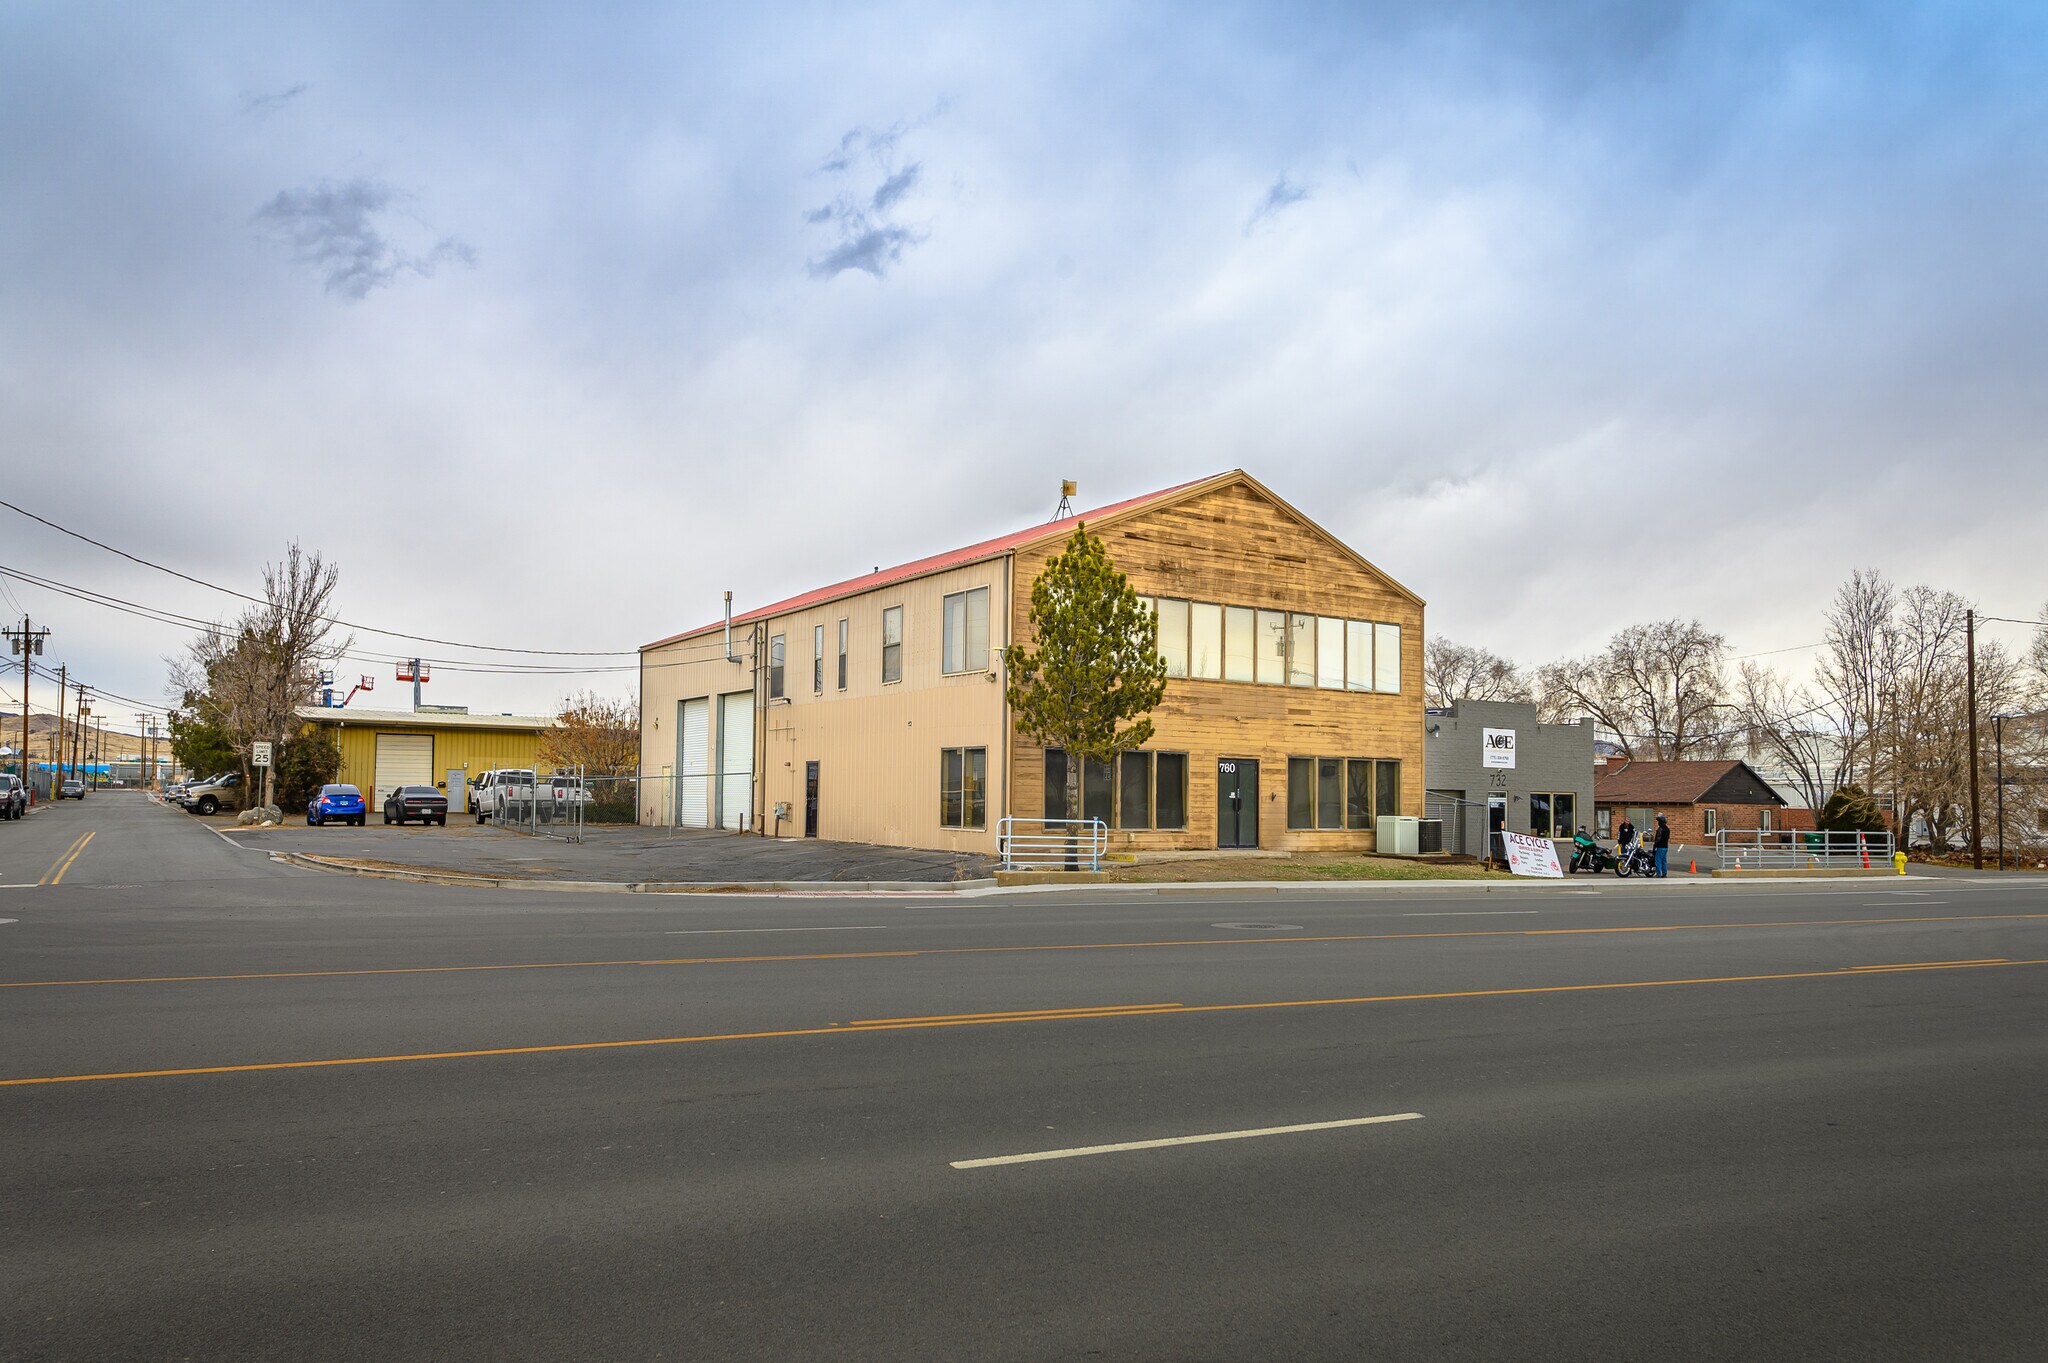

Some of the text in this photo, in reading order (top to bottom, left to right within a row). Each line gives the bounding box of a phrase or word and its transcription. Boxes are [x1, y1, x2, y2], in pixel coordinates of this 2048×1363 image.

[1485, 734, 1514, 749] ACE
[255, 754, 269, 763] 25
[1219, 763, 1236, 773] 760
[1490, 774, 1507, 787] 732
[1510, 834, 1550, 850] ACE CYCLE
